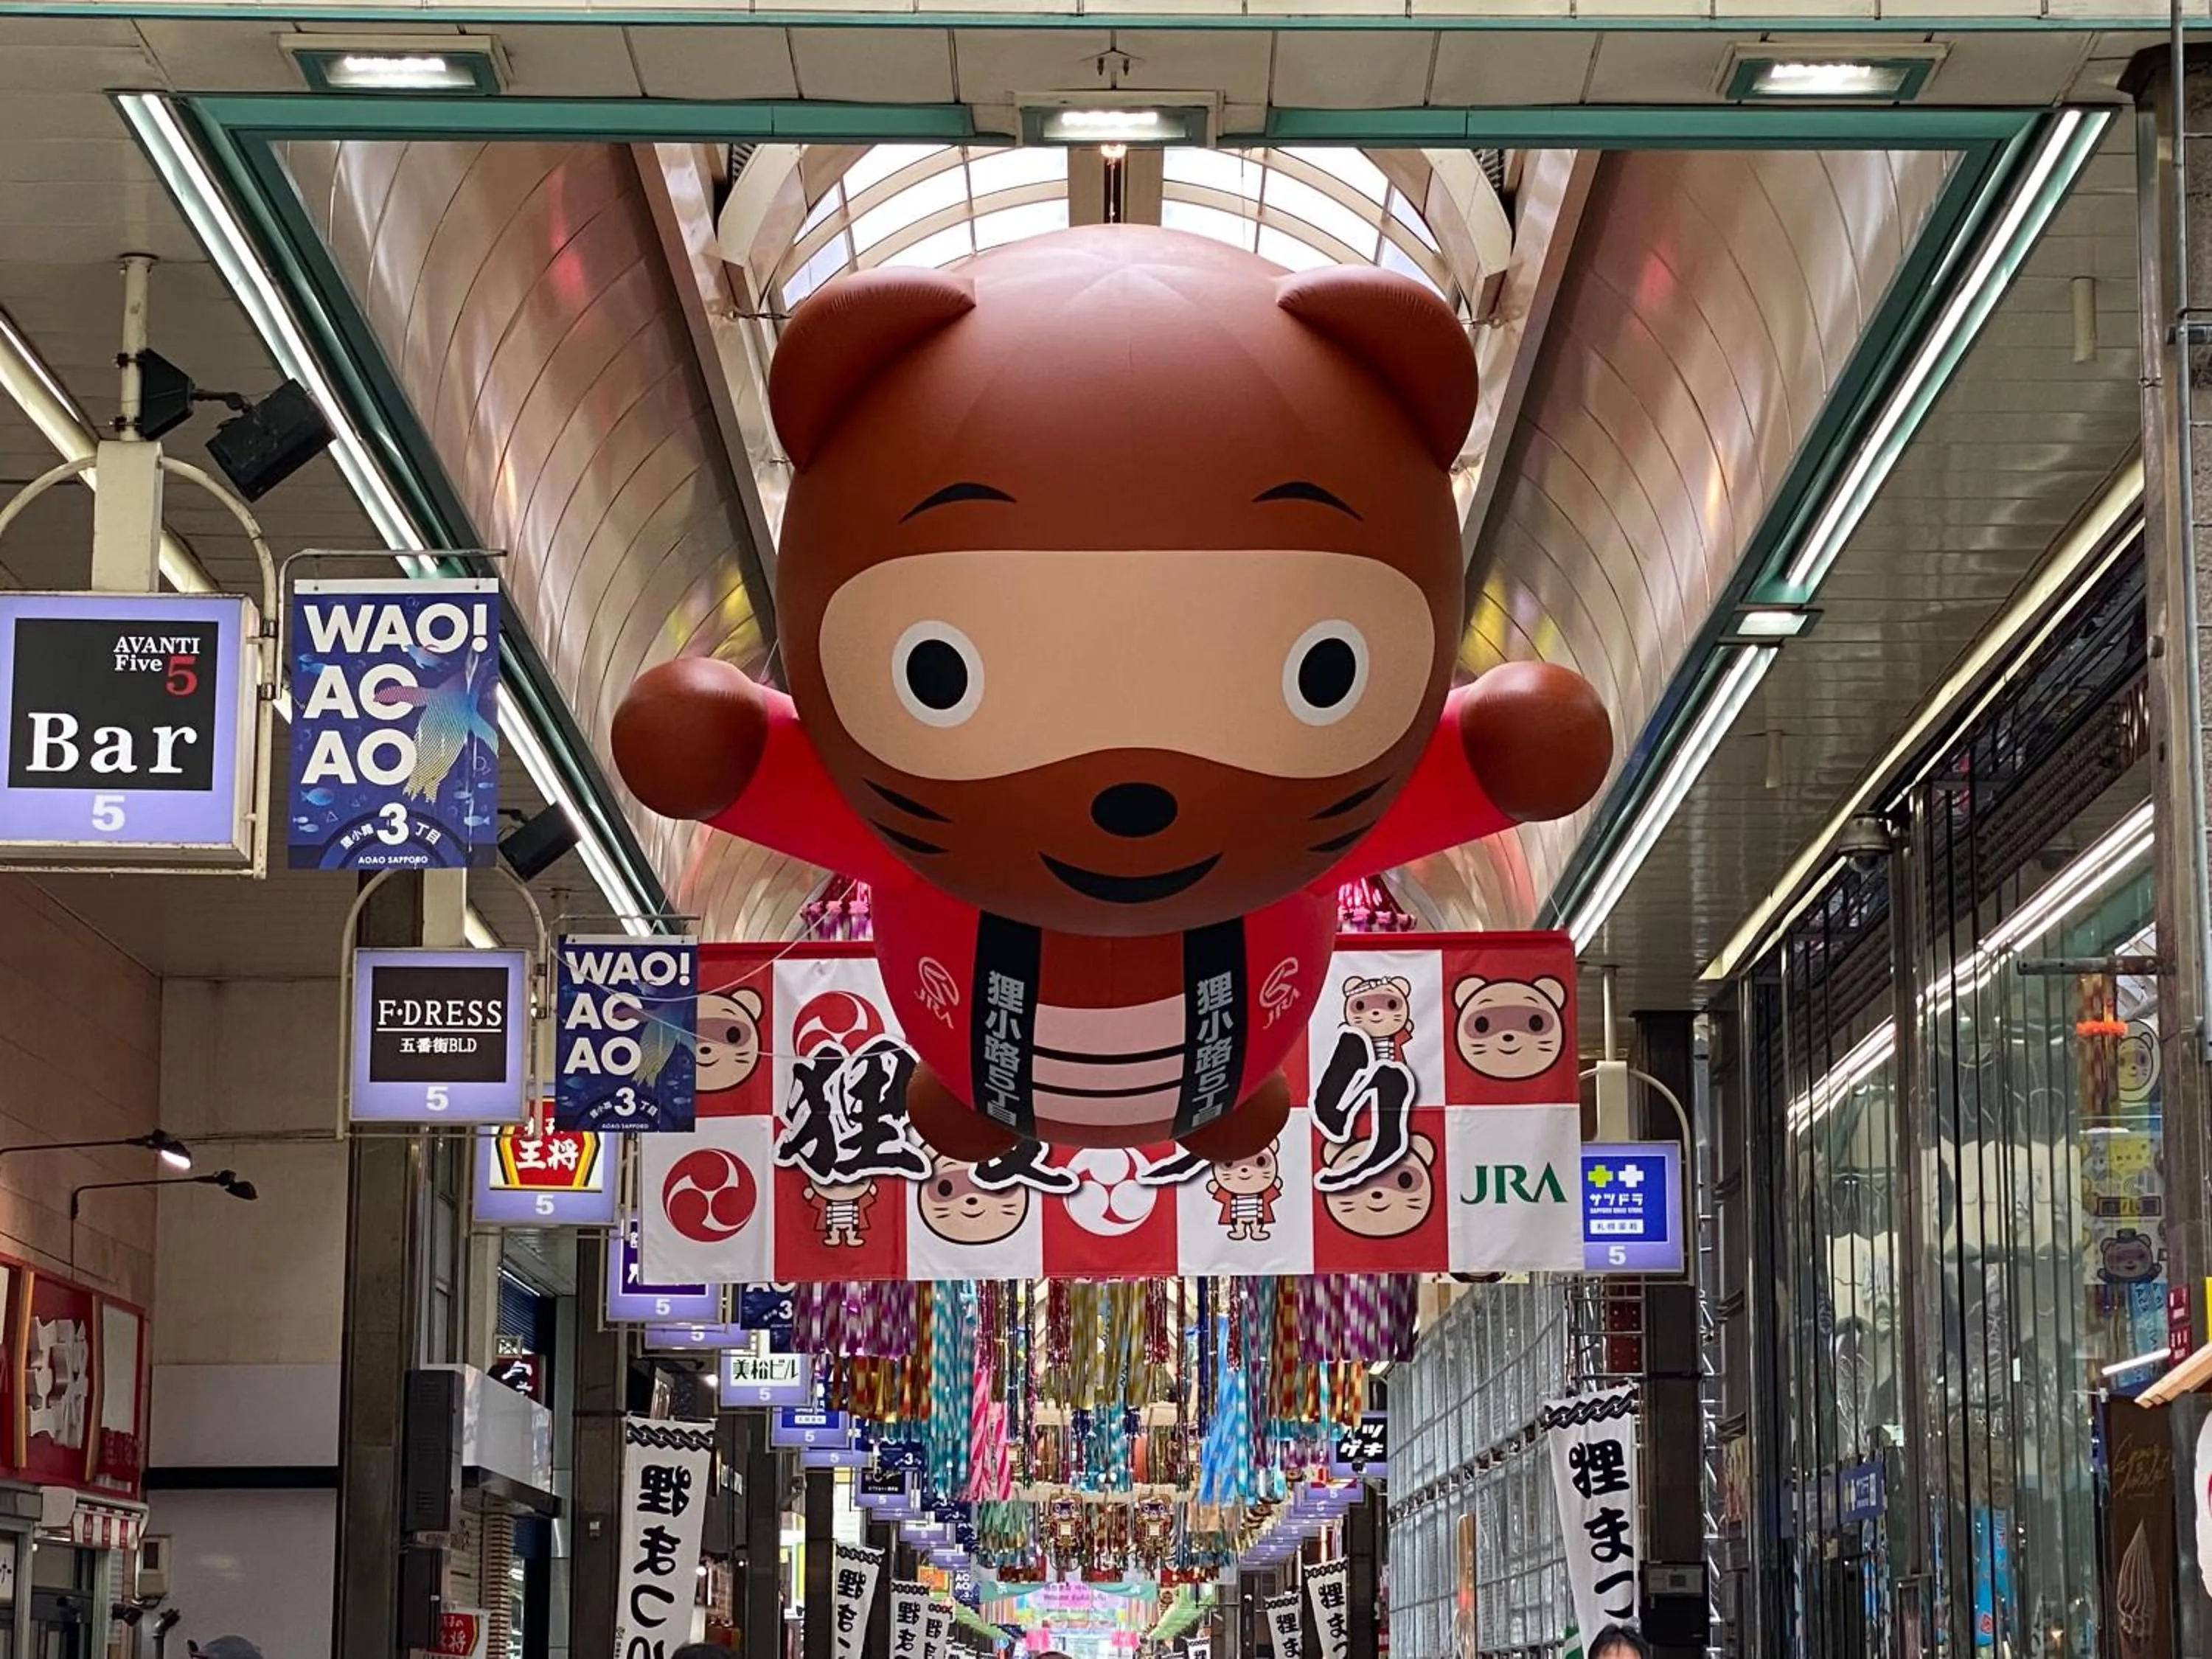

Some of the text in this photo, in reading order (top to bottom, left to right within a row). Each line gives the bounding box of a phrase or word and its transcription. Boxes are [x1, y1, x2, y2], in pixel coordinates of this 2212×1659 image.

[303, 602, 488, 653] WAO!
[114, 636, 201, 654] AVANTI
[114, 654, 198, 696] Five 5
[25, 712, 198, 775] Bar
[301, 728, 418, 785] AO
[92, 794, 125, 831] 5
[358, 855, 428, 865] AOAO SAPPORO
[564, 951, 690, 986] WAO!
[914, 988, 954, 1029] JRA
[1263, 988, 1301, 1030] JRA
[563, 1036, 641, 1076] AO
[984, 970, 1025, 1126] 狸小路5丁目
[1192, 971, 1234, 1127] 狸小路5丁目
[426, 1086, 449, 1111] 5
[516, 1138, 579, 1171] 王将
[1460, 1163, 1567, 1204] JRA
[535, 1194, 554, 1215] 5
[1590, 1193, 1644, 1206] サツドラ
[1608, 1246, 1627, 1265] 5
[655, 1298, 671, 1315] 5
[691, 1326, 706, 1341] 5
[733, 1359, 799, 1380] 美松ビル
[759, 1387, 771, 1401] 5
[805, 1430, 815, 1442] 5
[1340, 1439, 1384, 1457] ゲキ
[905, 1452, 914, 1465] 3
